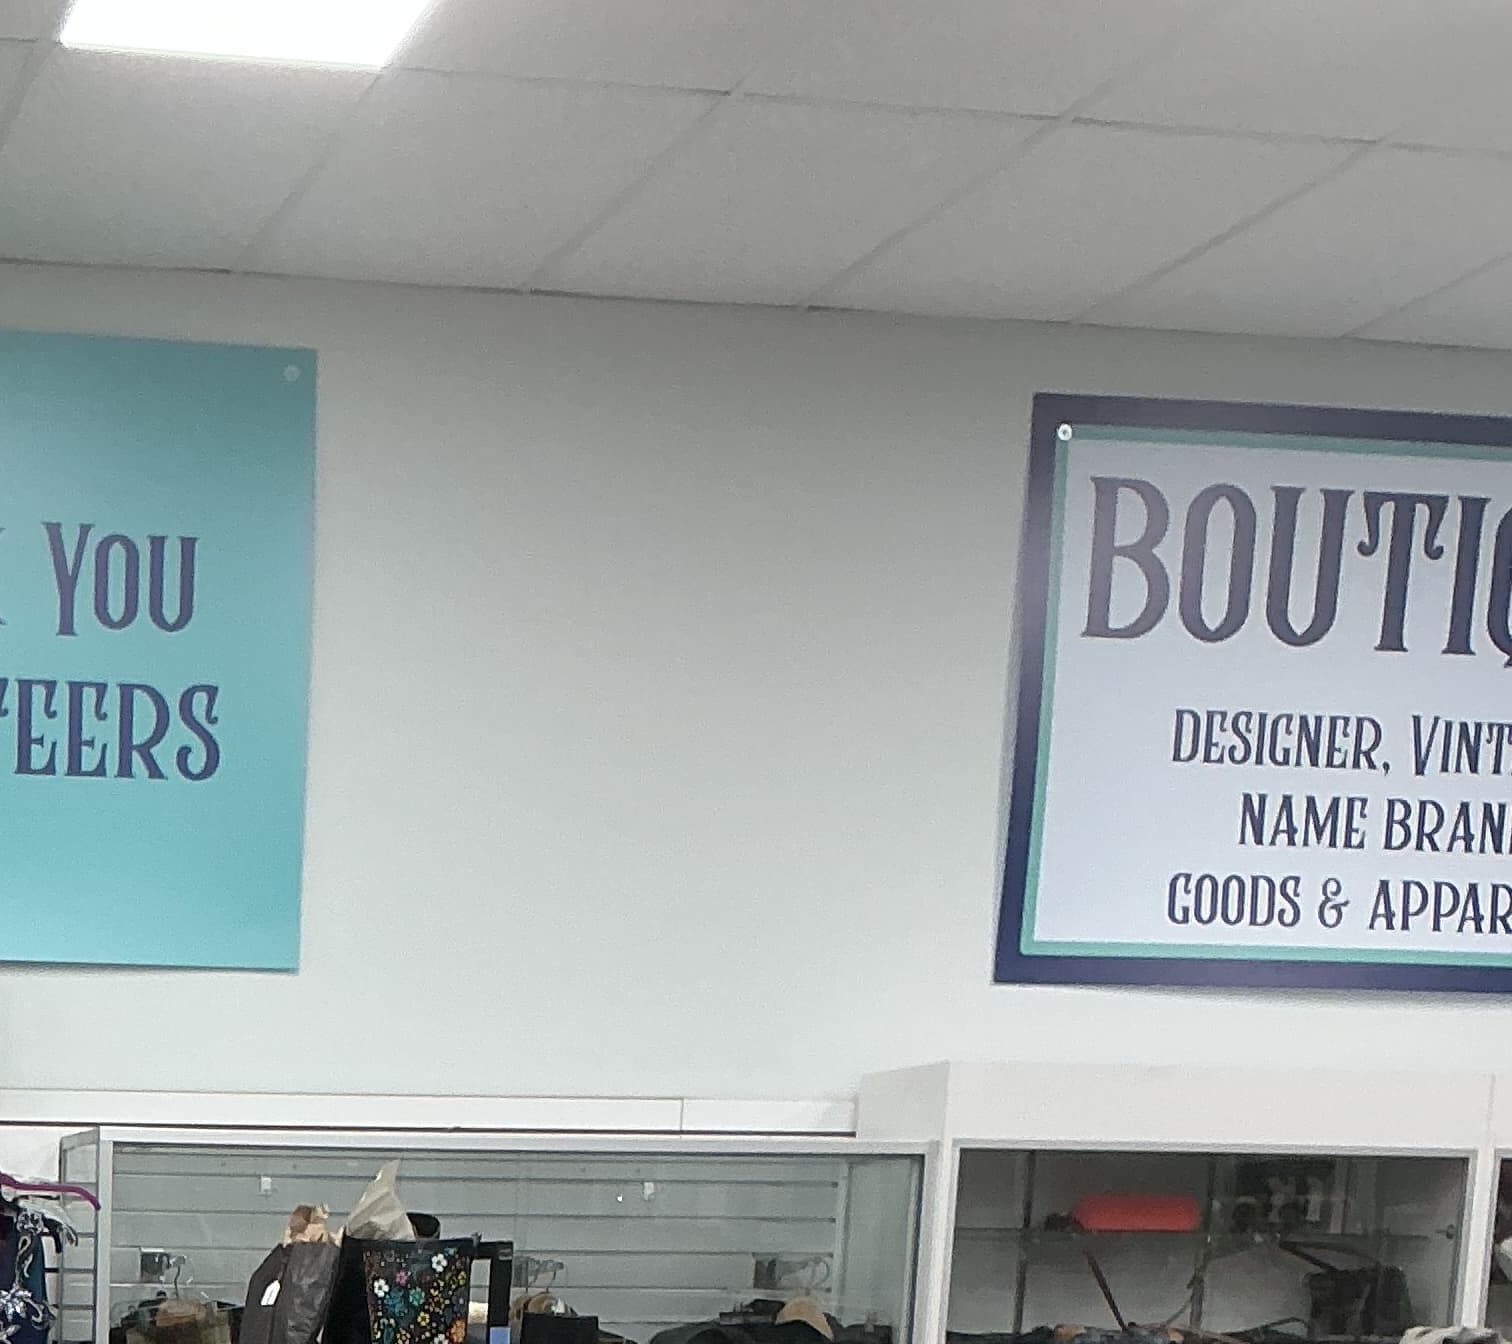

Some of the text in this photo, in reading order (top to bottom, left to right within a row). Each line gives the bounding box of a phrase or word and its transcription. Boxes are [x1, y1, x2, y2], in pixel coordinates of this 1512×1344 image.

[42, 521, 200, 637] YOU
[1172, 708, 1512, 777] DESIGNER, VINT
[1238, 793, 1512, 855] NAME BRAN
[1167, 872, 1301, 929] GOODS
[1317, 877, 1350, 929] &
